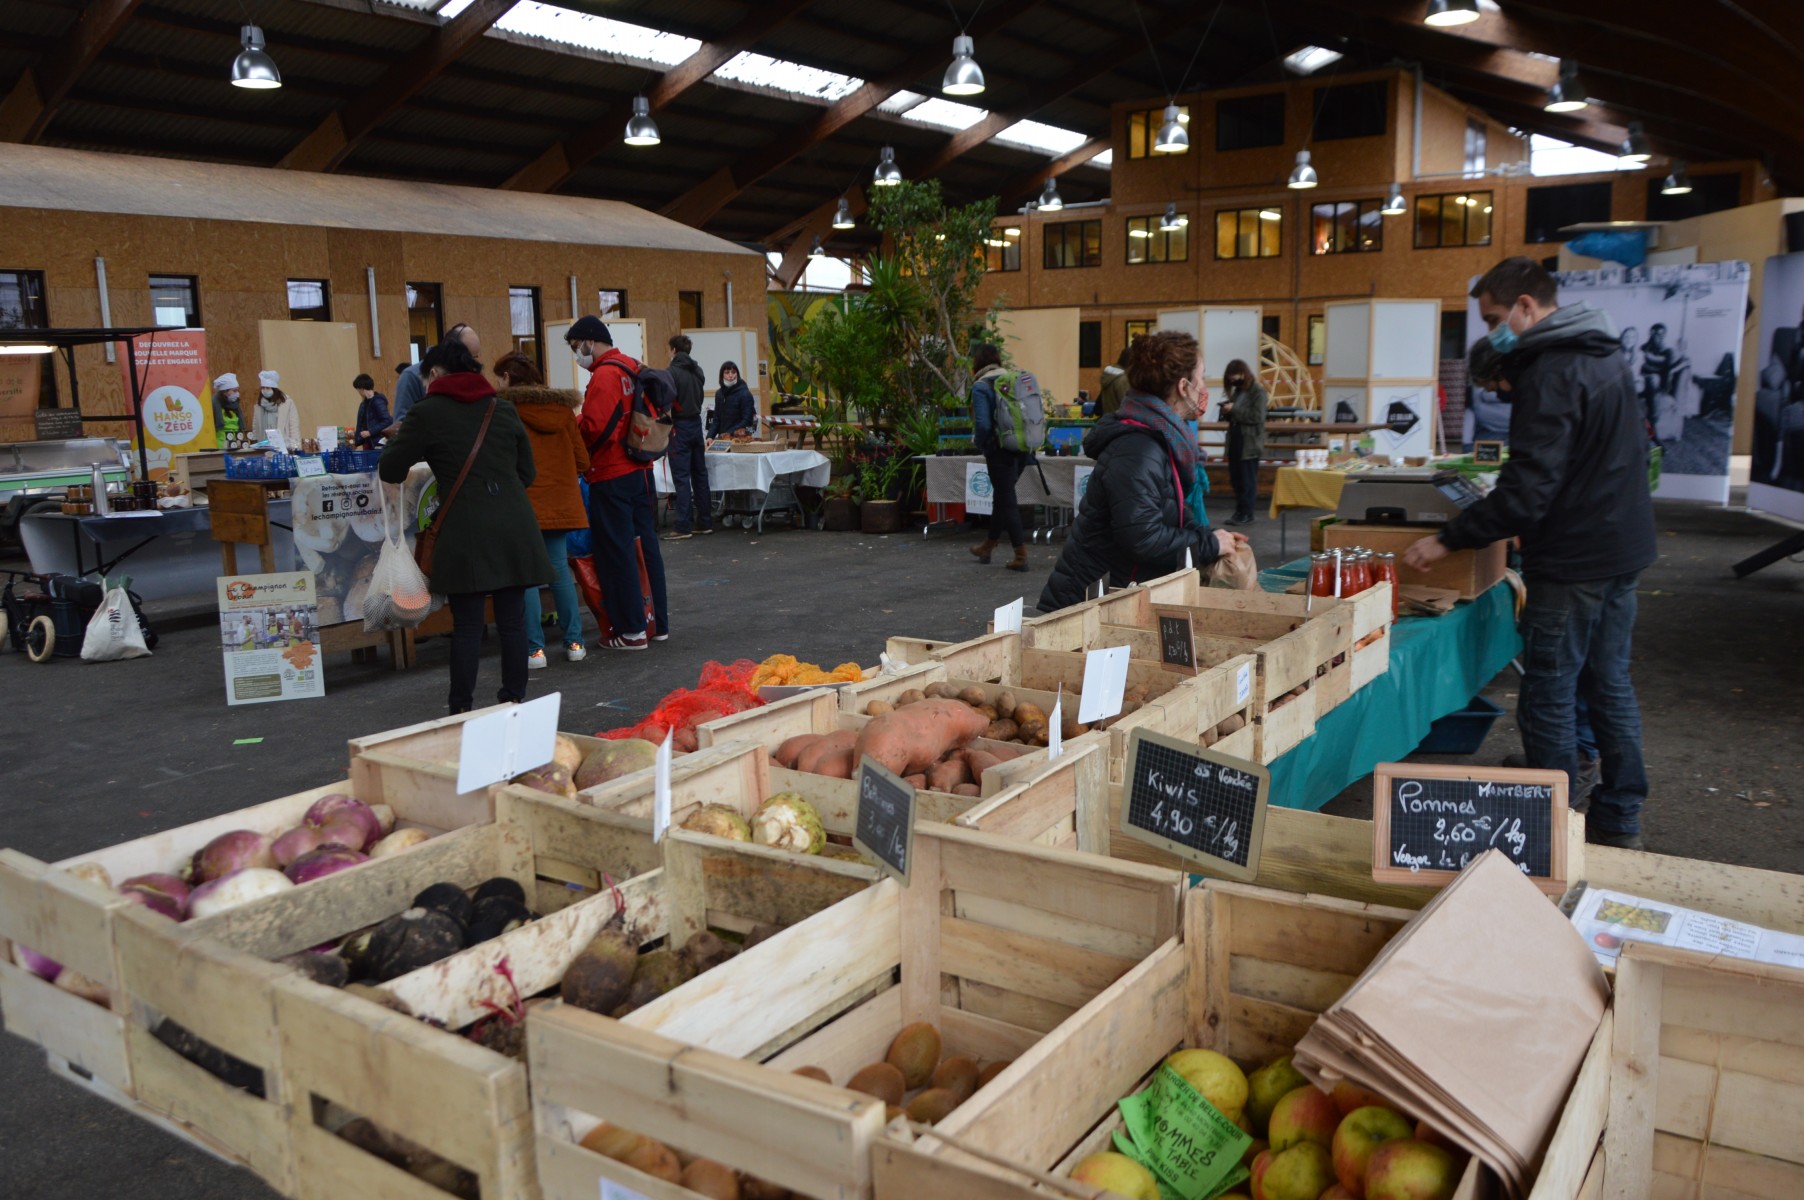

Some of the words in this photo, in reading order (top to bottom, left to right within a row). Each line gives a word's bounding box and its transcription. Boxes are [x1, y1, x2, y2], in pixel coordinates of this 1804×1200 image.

[312, 508, 382, 520] lechampignonurbain.f
[227, 584, 237, 592] Le
[241, 583, 287, 592] Champignon
[1148, 768, 1198, 806] Kiwis
[1218, 768, 1252, 790] Vendée
[1399, 781, 1476, 814] Pommes
[1478, 782, 1552, 799] MONTBERT
[1151, 800, 1193, 835] 4,90
[1188, 1091, 1200, 1104] DE
[1154, 1115, 1215, 1167] POMMES
[1158, 1162, 1180, 1183] KISS
[1166, 1147, 1198, 1181] TABLE
